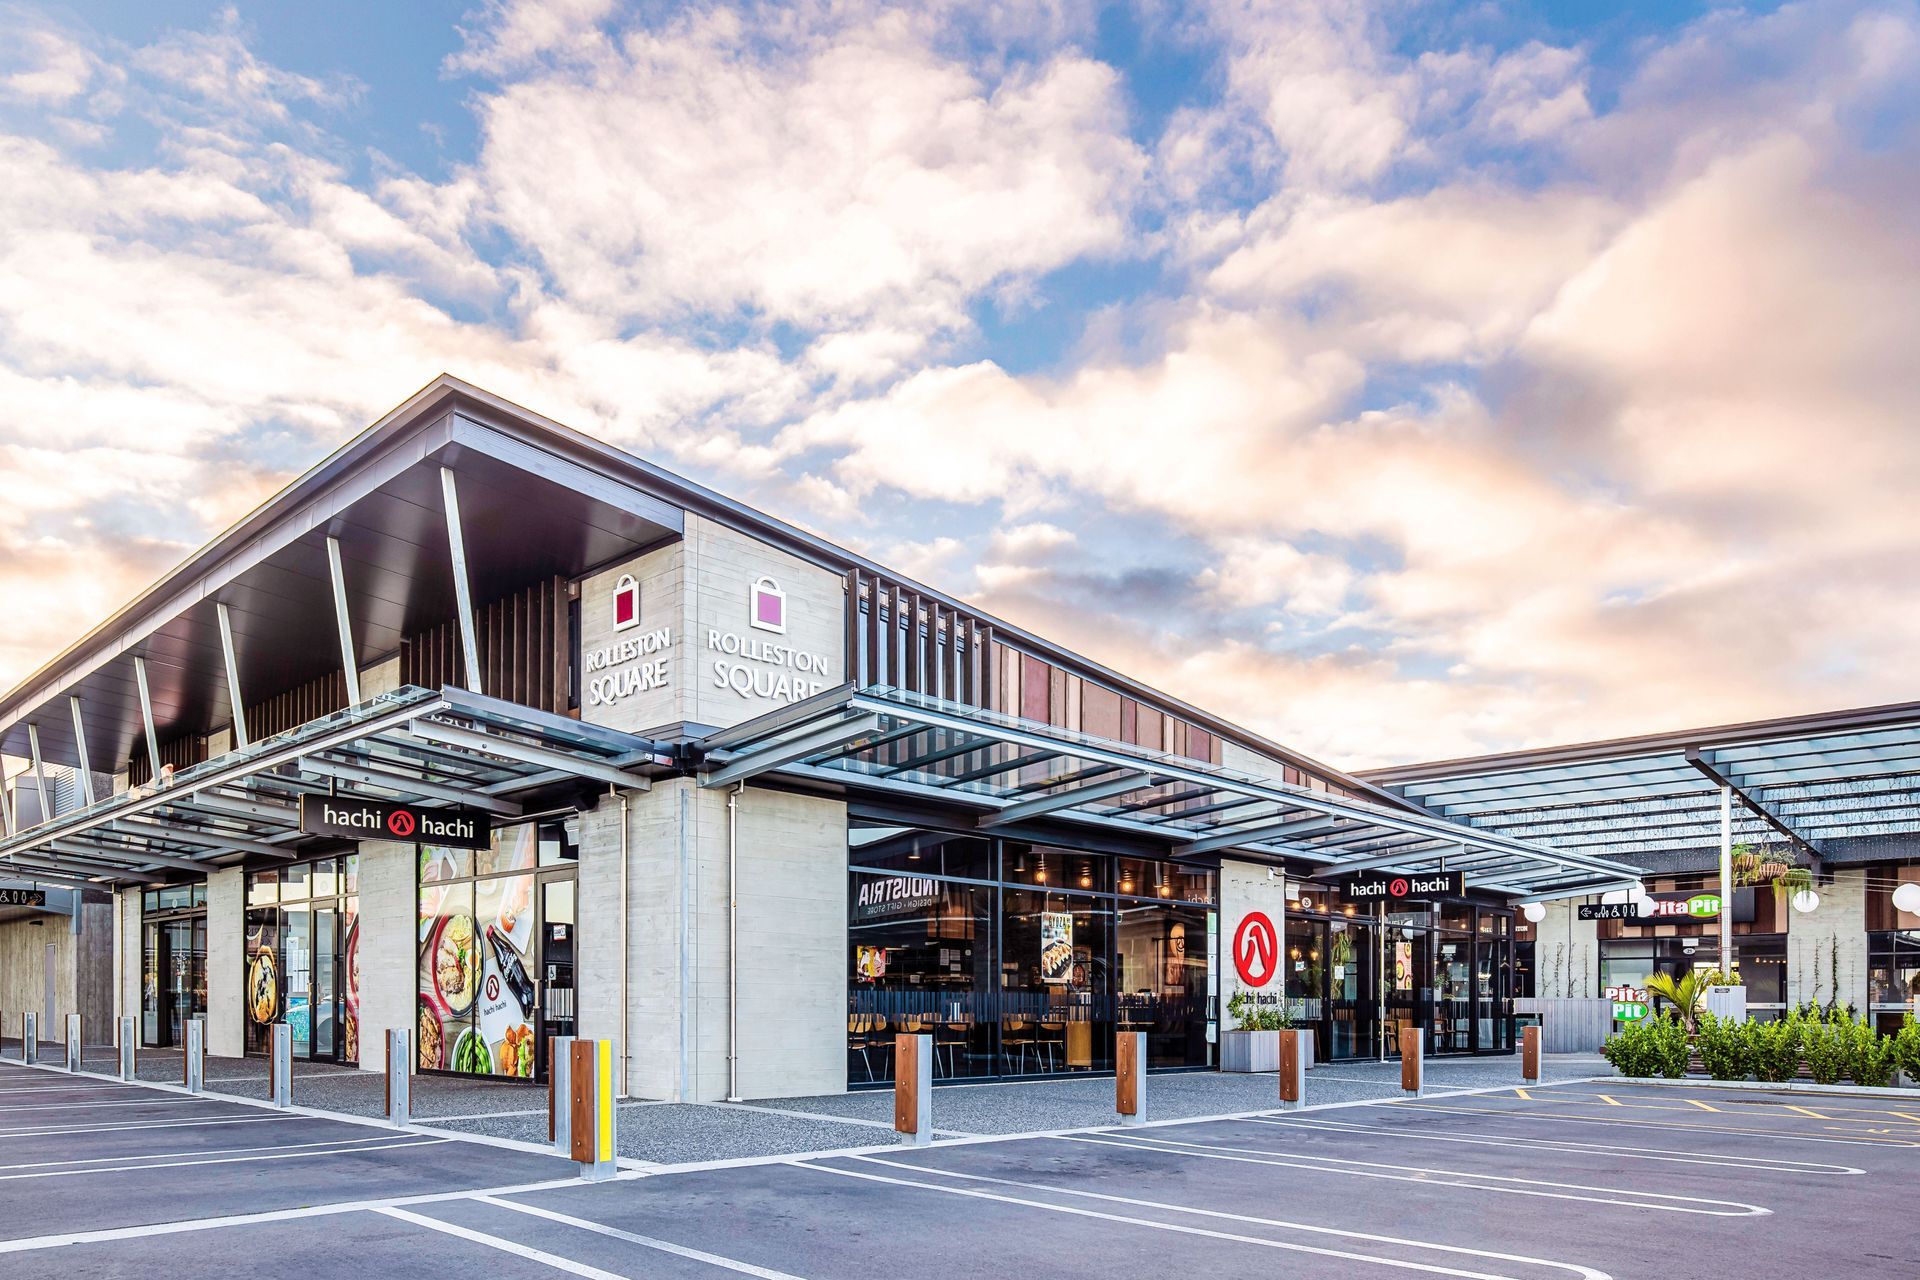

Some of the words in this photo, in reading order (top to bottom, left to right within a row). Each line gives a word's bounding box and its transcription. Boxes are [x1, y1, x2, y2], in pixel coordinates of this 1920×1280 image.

[586, 627, 671, 673] ROLLESTON
[708, 628, 828, 676] ROLLESTON
[589, 658, 668, 706] SQUARE
[324, 804, 381, 829] hachi
[421, 814, 474, 838] hachi
[1350, 881, 1386, 897] hachi
[1411, 877, 1450, 893] hachi
[1690, 899, 1720, 913] Pit
[1257, 992, 1278, 1005] hachi
[1605, 987, 1649, 1002] Pita
[1612, 1003, 1642, 1018] Pit
